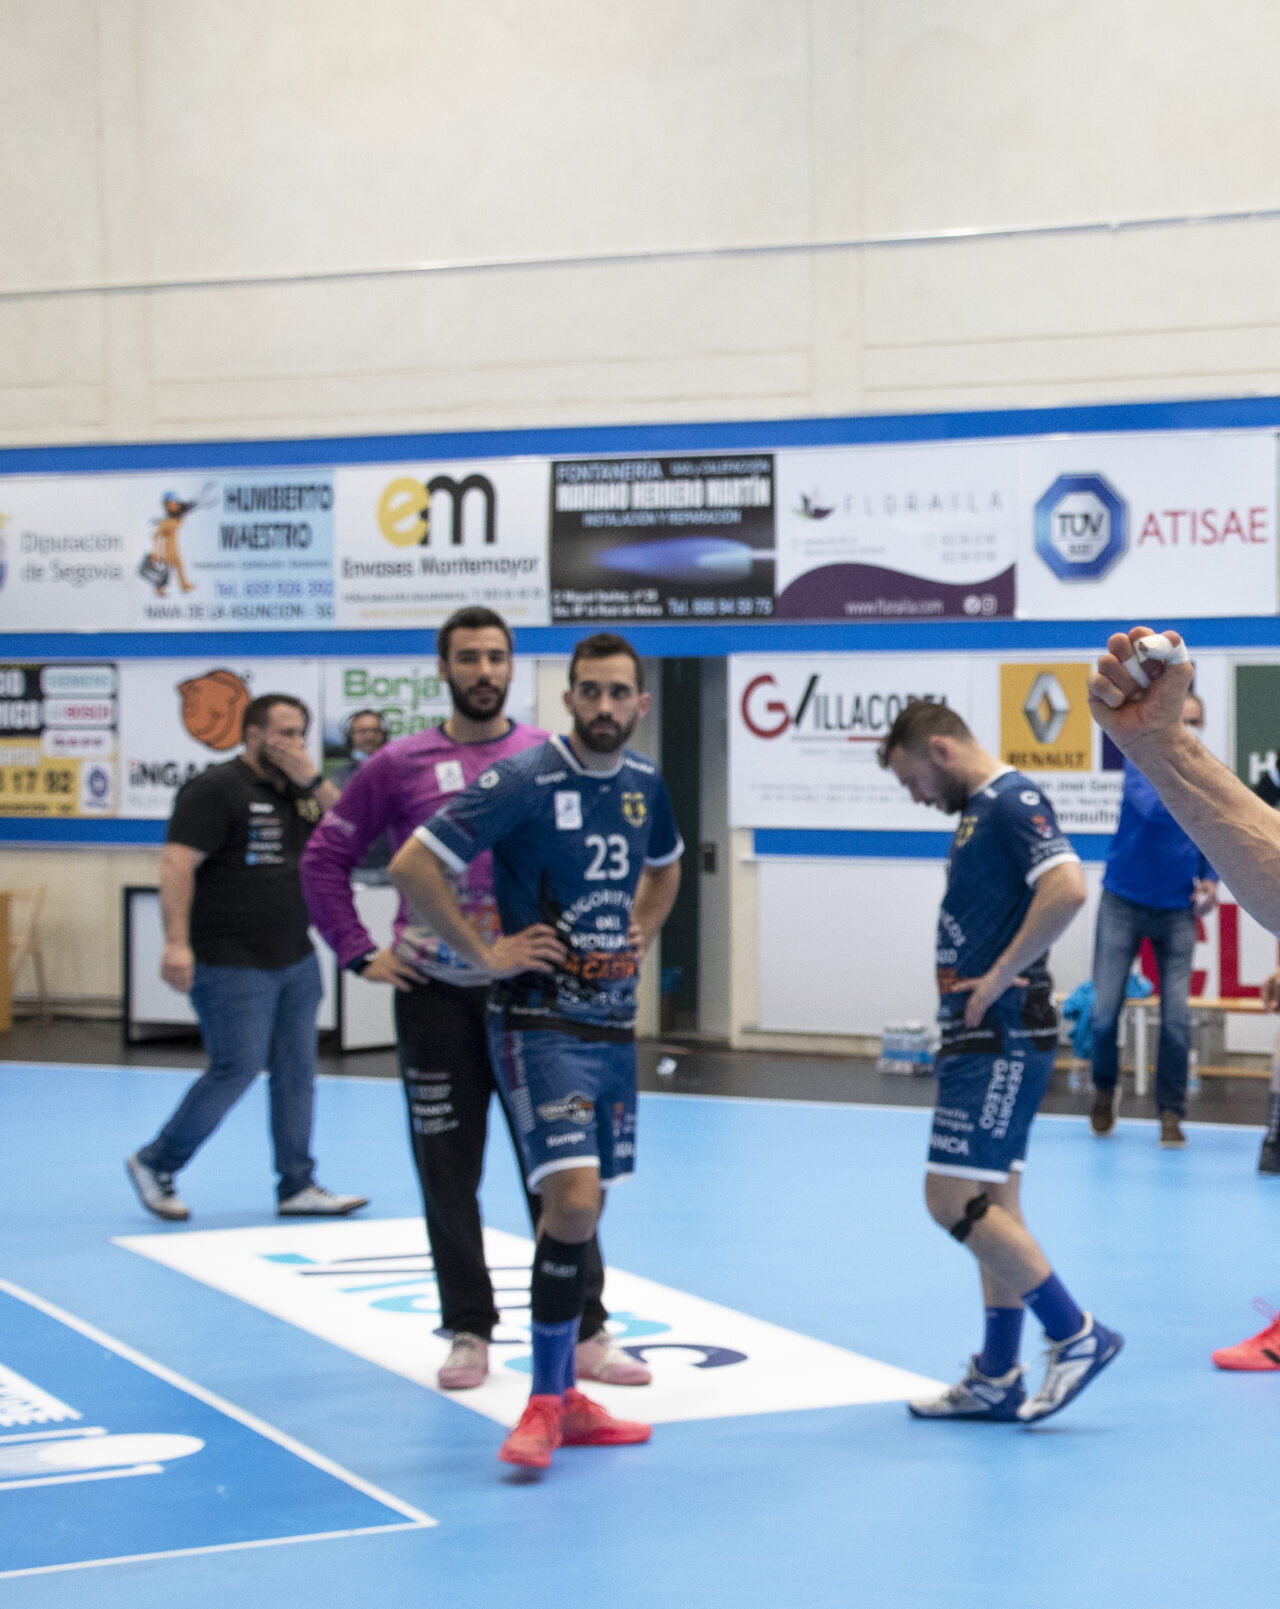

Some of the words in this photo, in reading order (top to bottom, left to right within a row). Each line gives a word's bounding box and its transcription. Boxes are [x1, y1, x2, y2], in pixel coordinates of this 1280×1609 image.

[223, 484, 334, 513] HUMBERTO
[218, 522, 313, 550] MAESTRO
[1138, 507, 1268, 546] ATISAE
[49, 559, 123, 588] Segovia
[341, 557, 414, 578] Envases
[418, 555, 540, 582] Montemayor
[1006, 752, 1084, 767] RENAULT
[584, 833, 630, 881] 23
